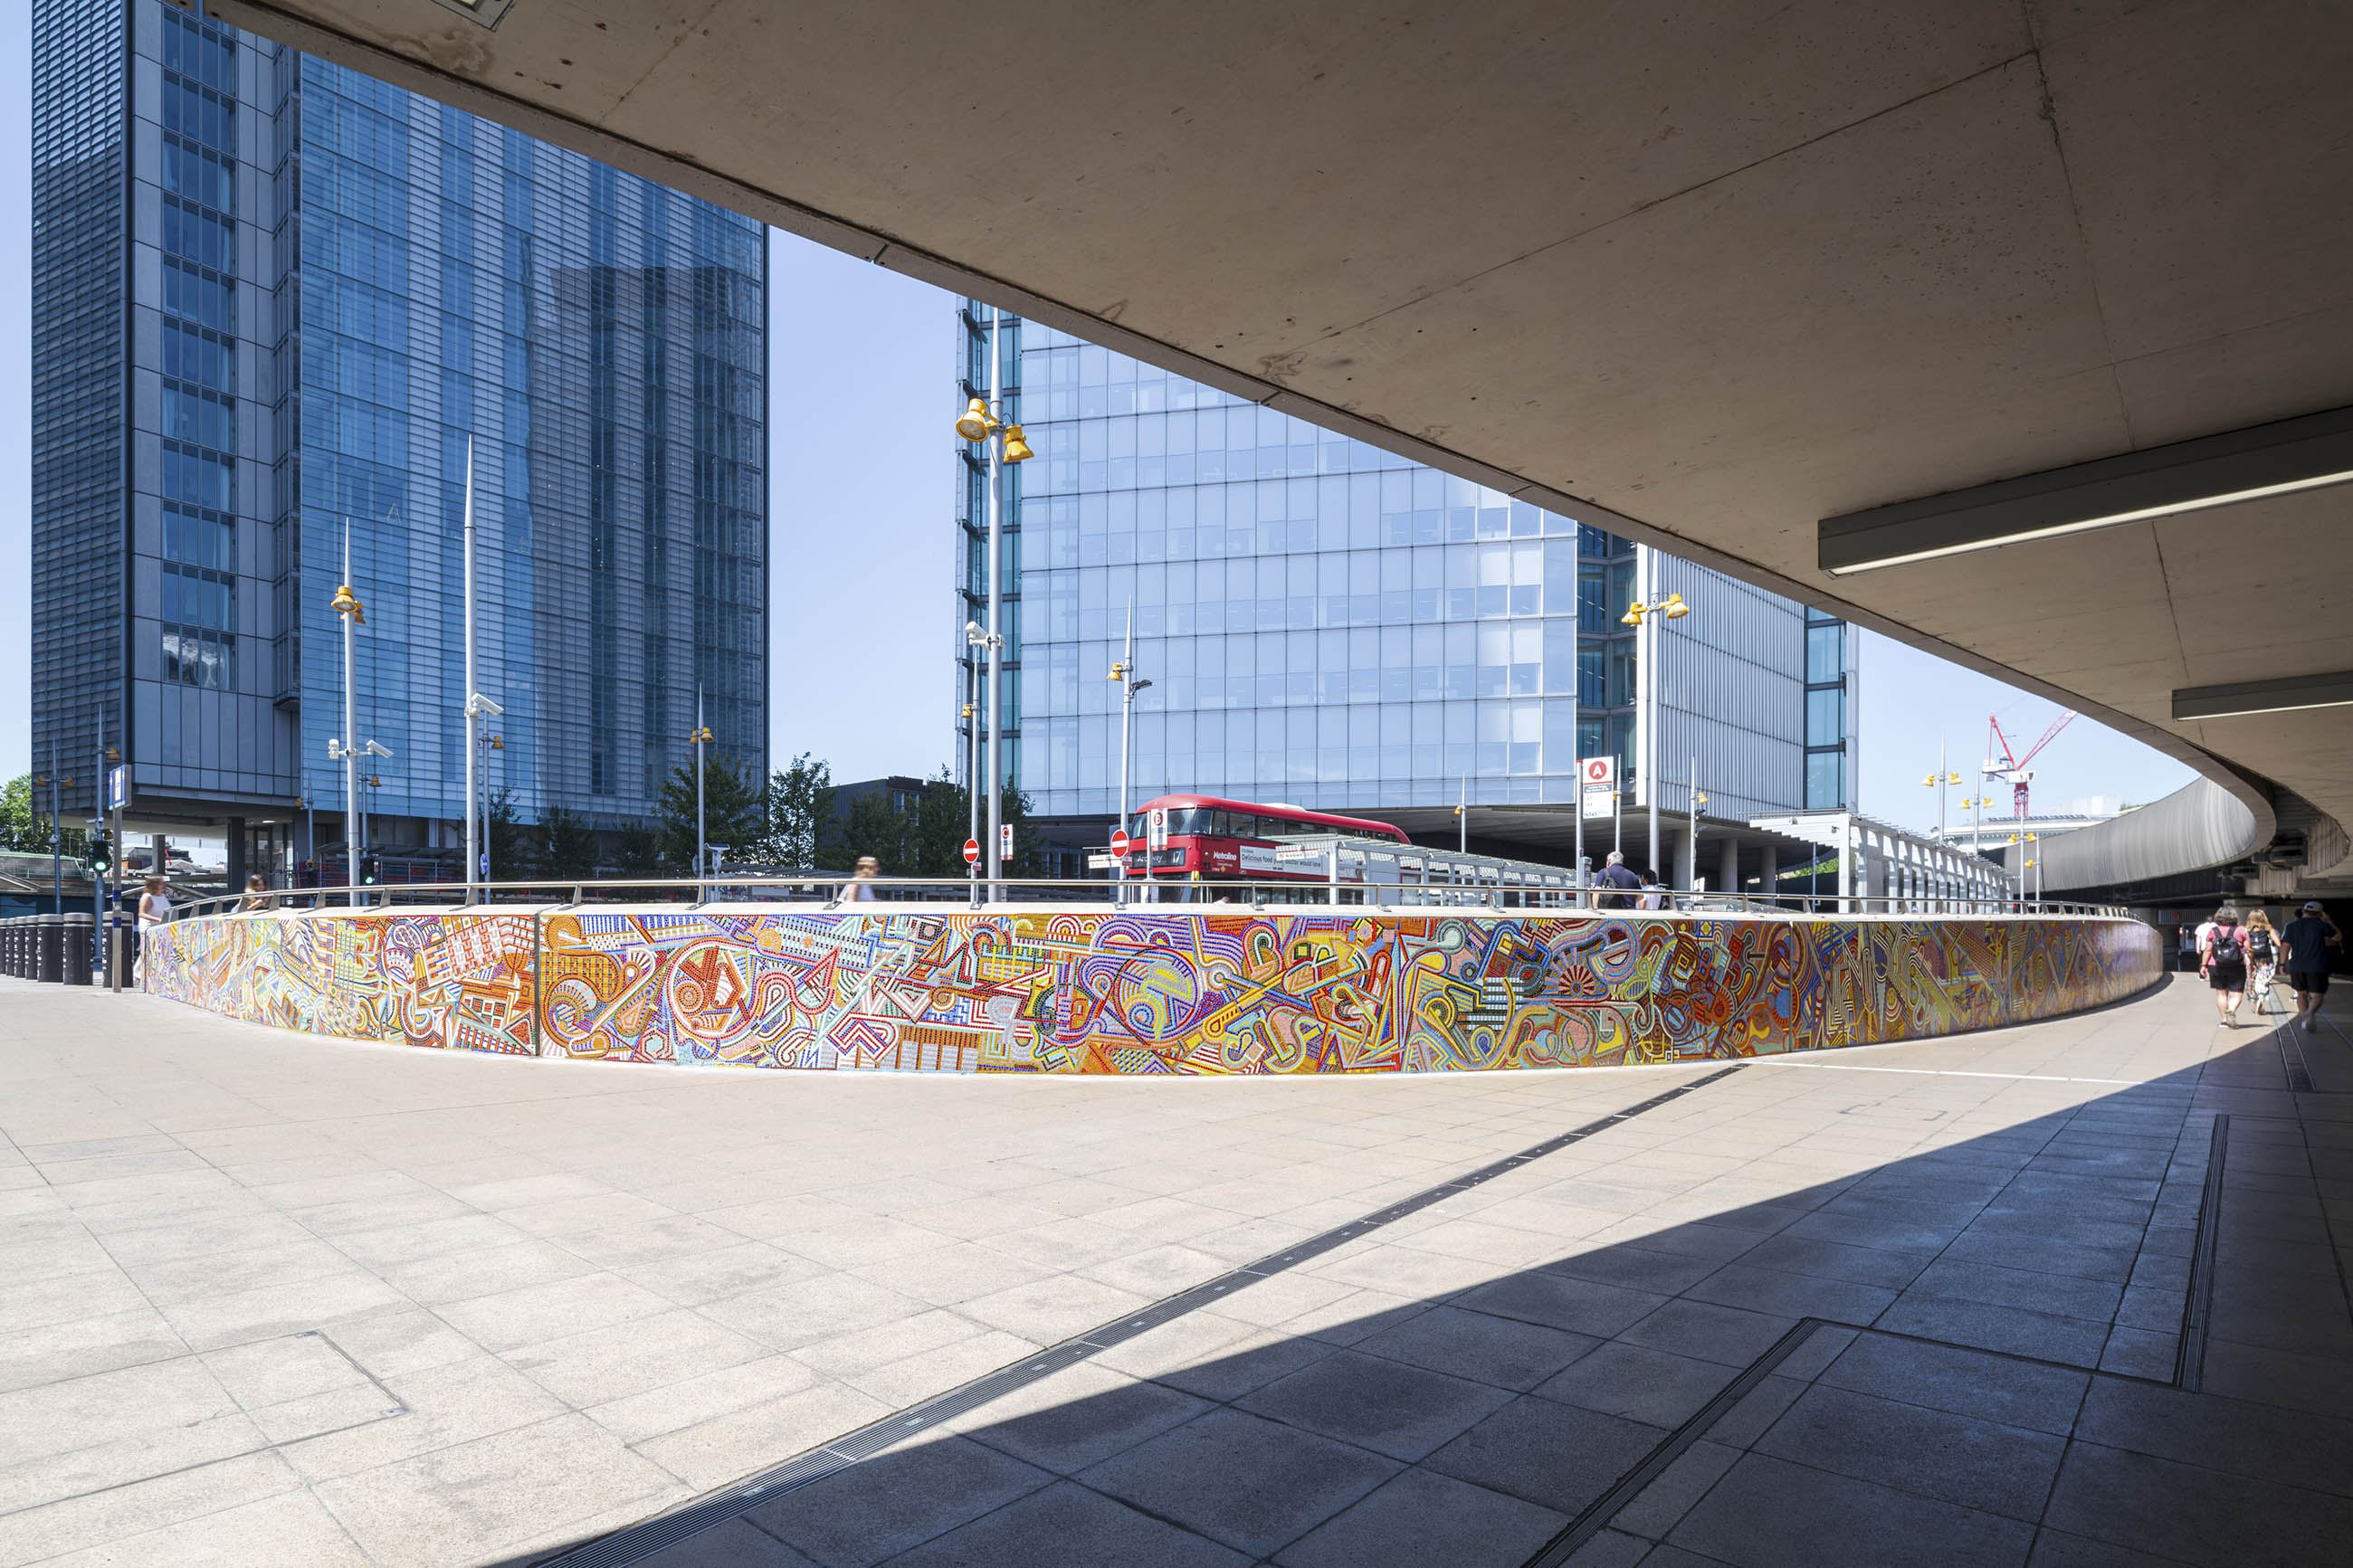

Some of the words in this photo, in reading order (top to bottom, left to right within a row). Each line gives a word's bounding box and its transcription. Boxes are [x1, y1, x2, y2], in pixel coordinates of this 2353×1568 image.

[1593, 765, 1603, 776] A
[1155, 813, 1161, 824] B
[1137, 855, 1163, 863] Arcway
[1173, 851, 1181, 863] 17
[1213, 851, 1237, 861] Metroline
[1242, 854, 1262, 862] Delicious
